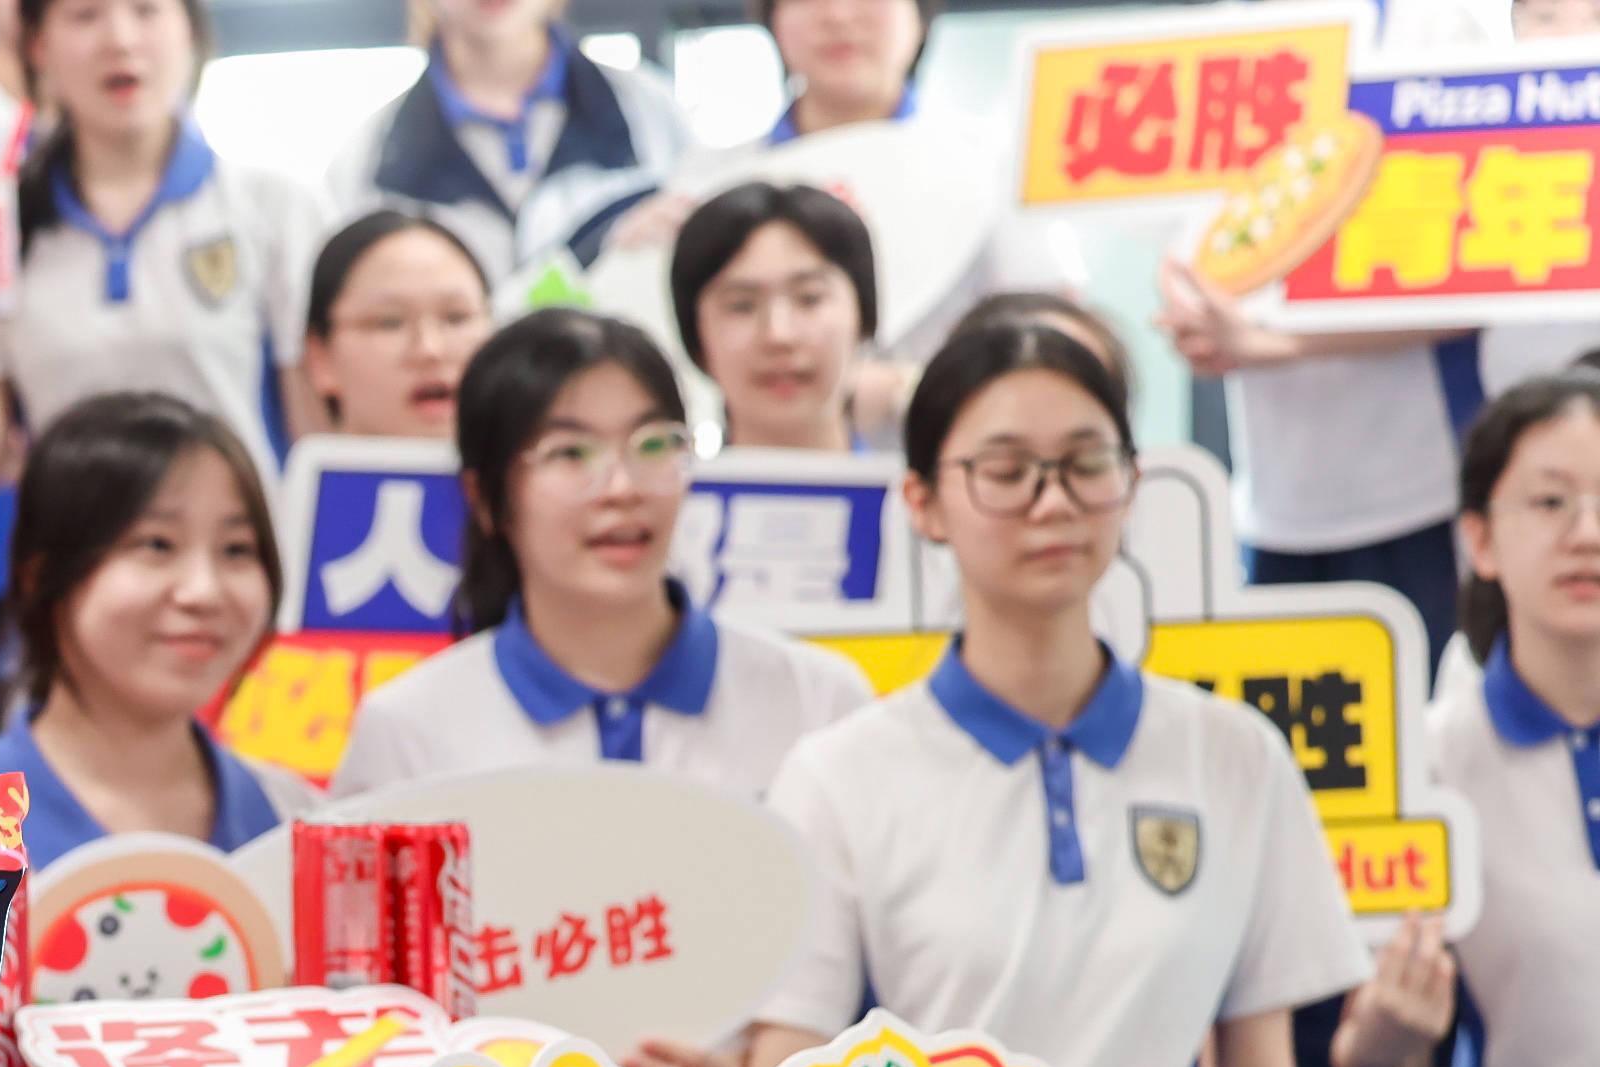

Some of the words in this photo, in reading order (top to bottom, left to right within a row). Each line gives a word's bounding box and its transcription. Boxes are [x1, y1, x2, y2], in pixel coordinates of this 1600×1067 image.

[1063, 50, 1308, 184] 必胜
[1390, 77, 1512, 129] Pizza
[1333, 146, 1594, 291] 青年
[321, 480, 460, 618] 人
[1195, 672, 1366, 790] 胜
